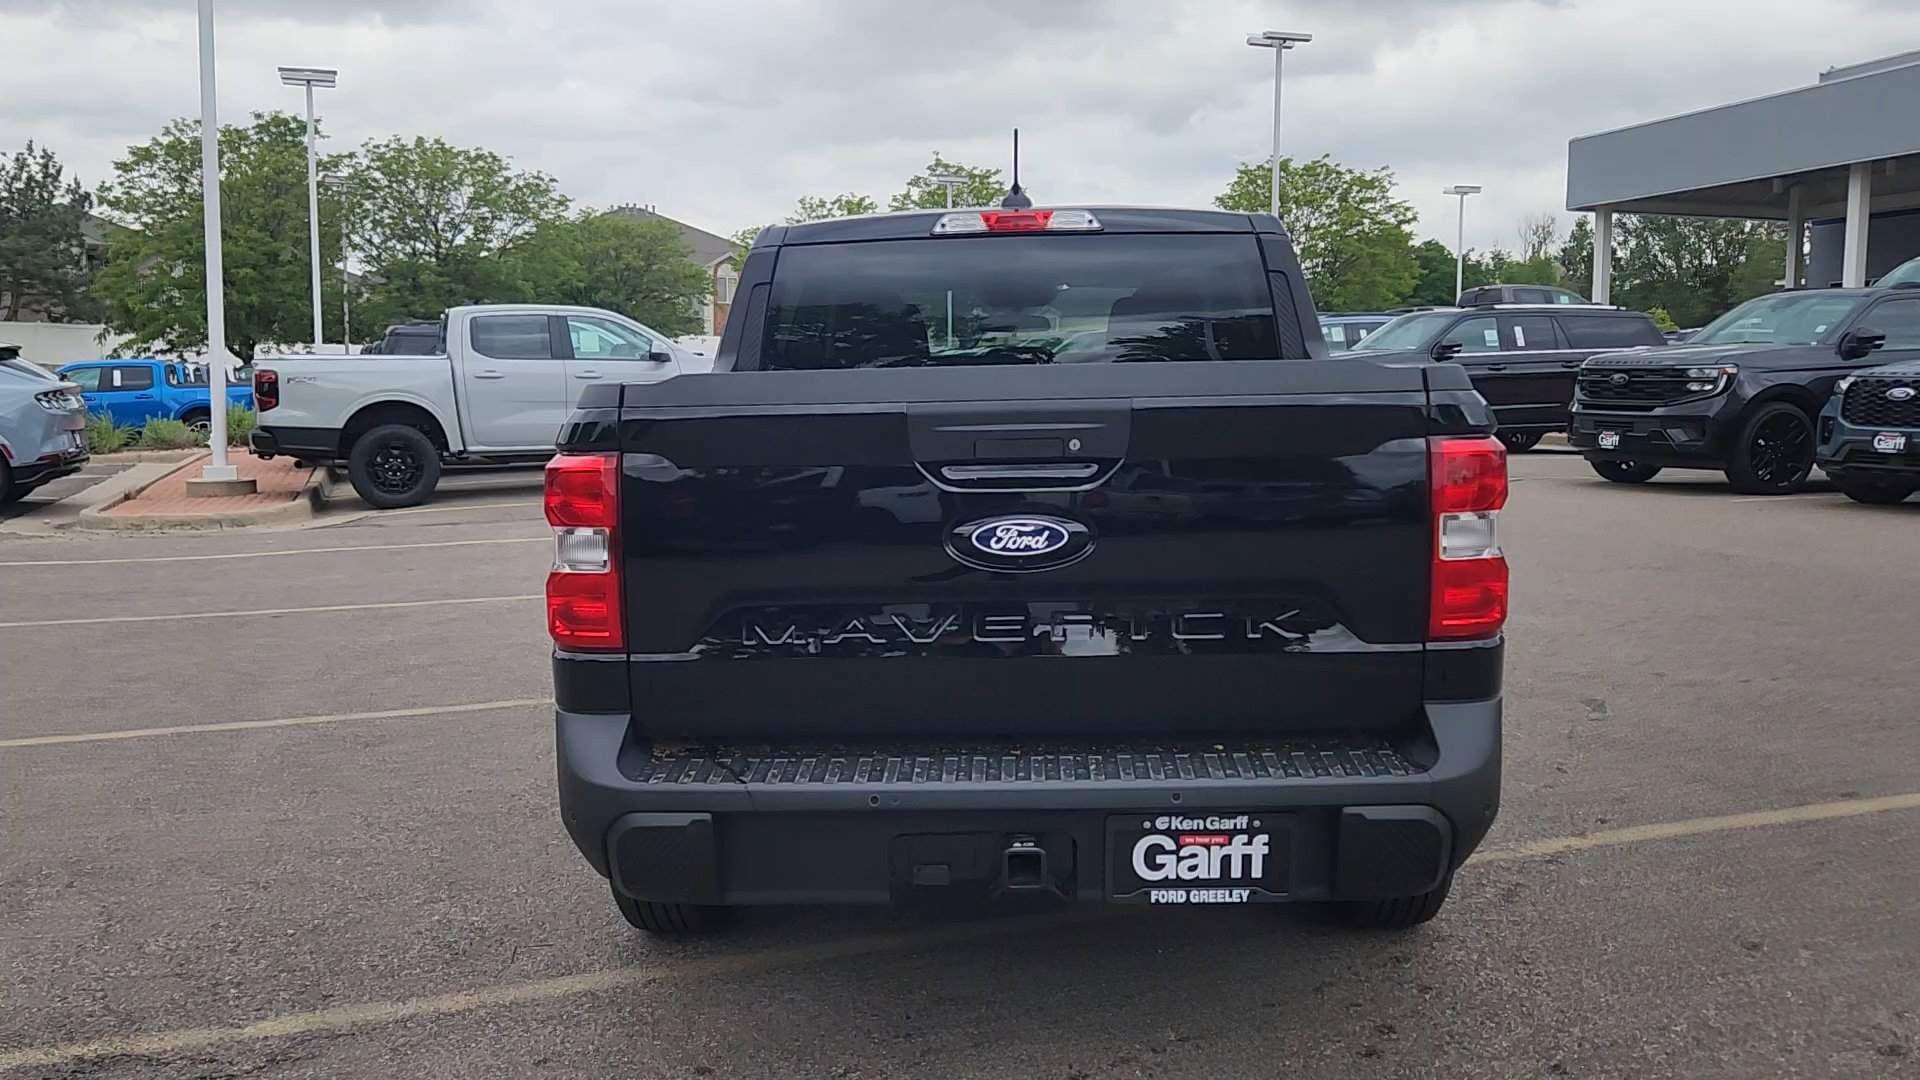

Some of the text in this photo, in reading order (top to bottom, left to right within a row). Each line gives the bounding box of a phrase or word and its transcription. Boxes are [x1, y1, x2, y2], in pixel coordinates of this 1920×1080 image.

[1873, 436, 1906, 450] Garff
[989, 525, 1051, 550] Ford
[742, 611, 1303, 645] MAVERICK
[1171, 816, 1249, 830] Ken Garff
[1132, 834, 1270, 881] Garff
[1150, 890, 1250, 904] FORD GREELEY
